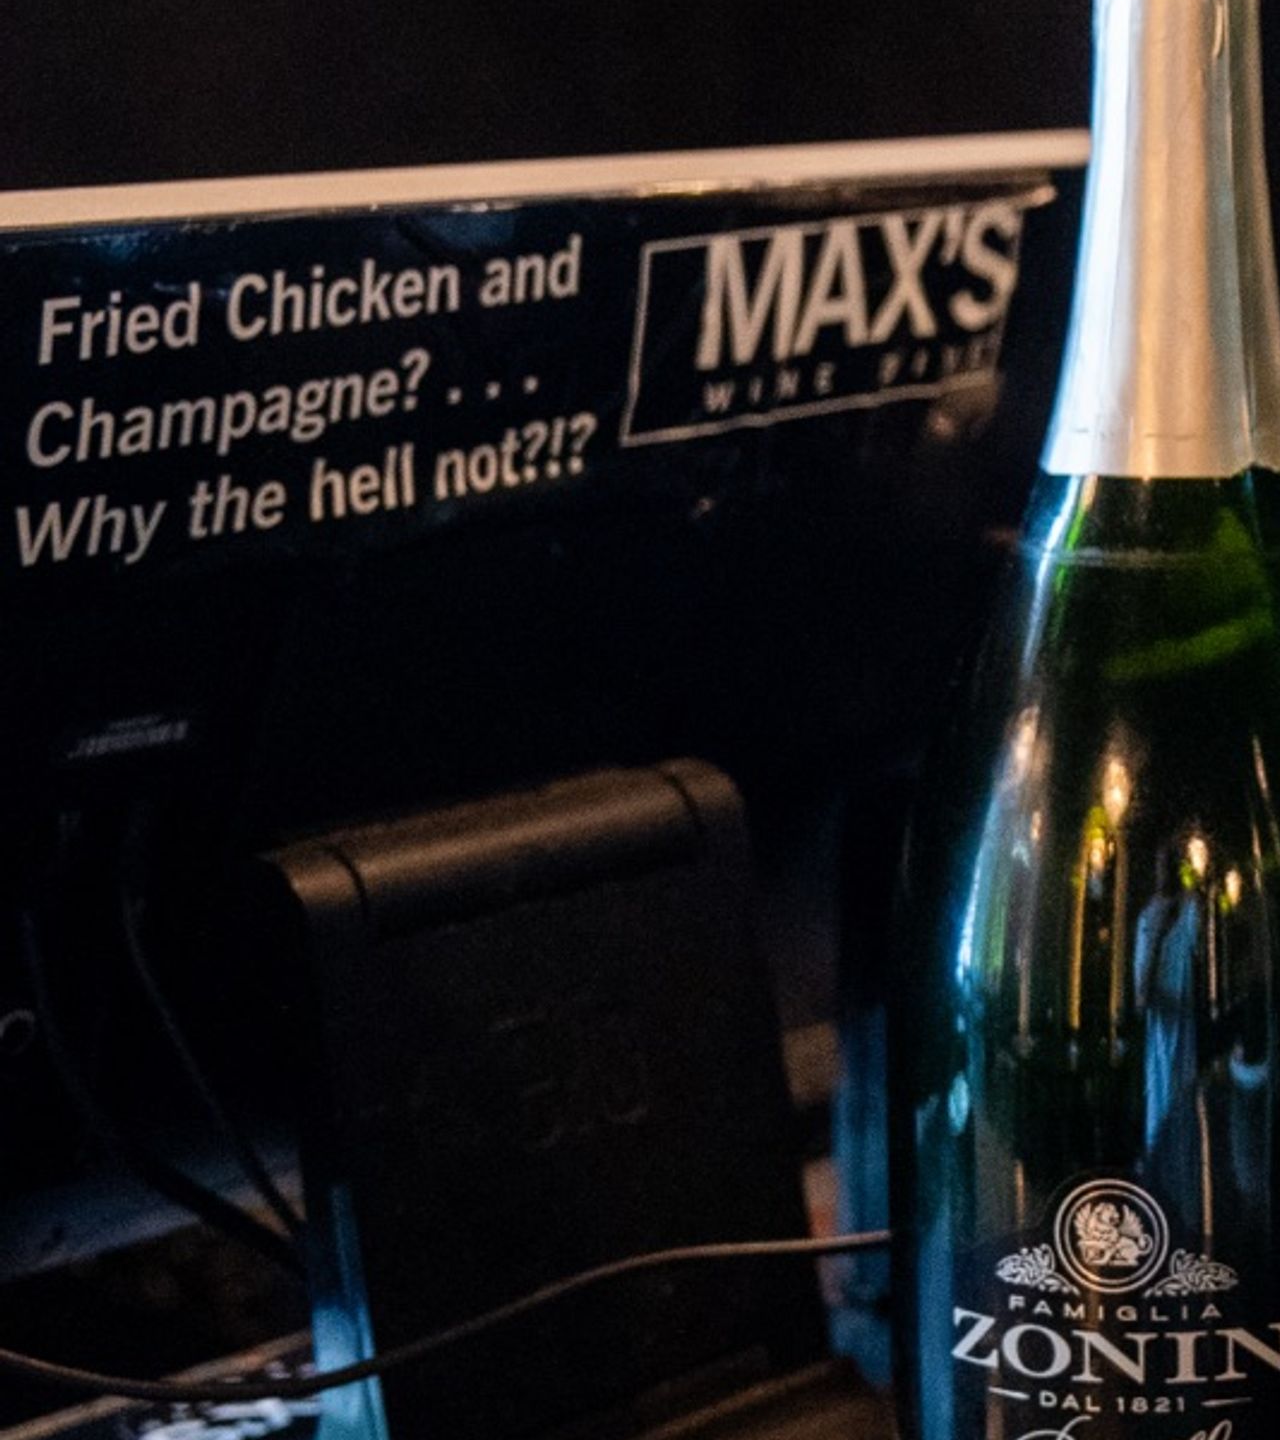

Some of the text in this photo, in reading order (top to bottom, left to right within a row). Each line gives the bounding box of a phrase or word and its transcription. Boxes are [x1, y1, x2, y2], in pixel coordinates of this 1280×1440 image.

[36, 235, 584, 366] Fried Chicken and
[692, 200, 1022, 372] MAX'S
[26, 348, 429, 468] Champagne?
[702, 359, 837, 416] WINE
[13, 412, 599, 570] Why the hell not?!?
[1008, 1294, 1225, 1324] FAMIGLIA
[1038, 1391, 1187, 1415] DAL 1821
